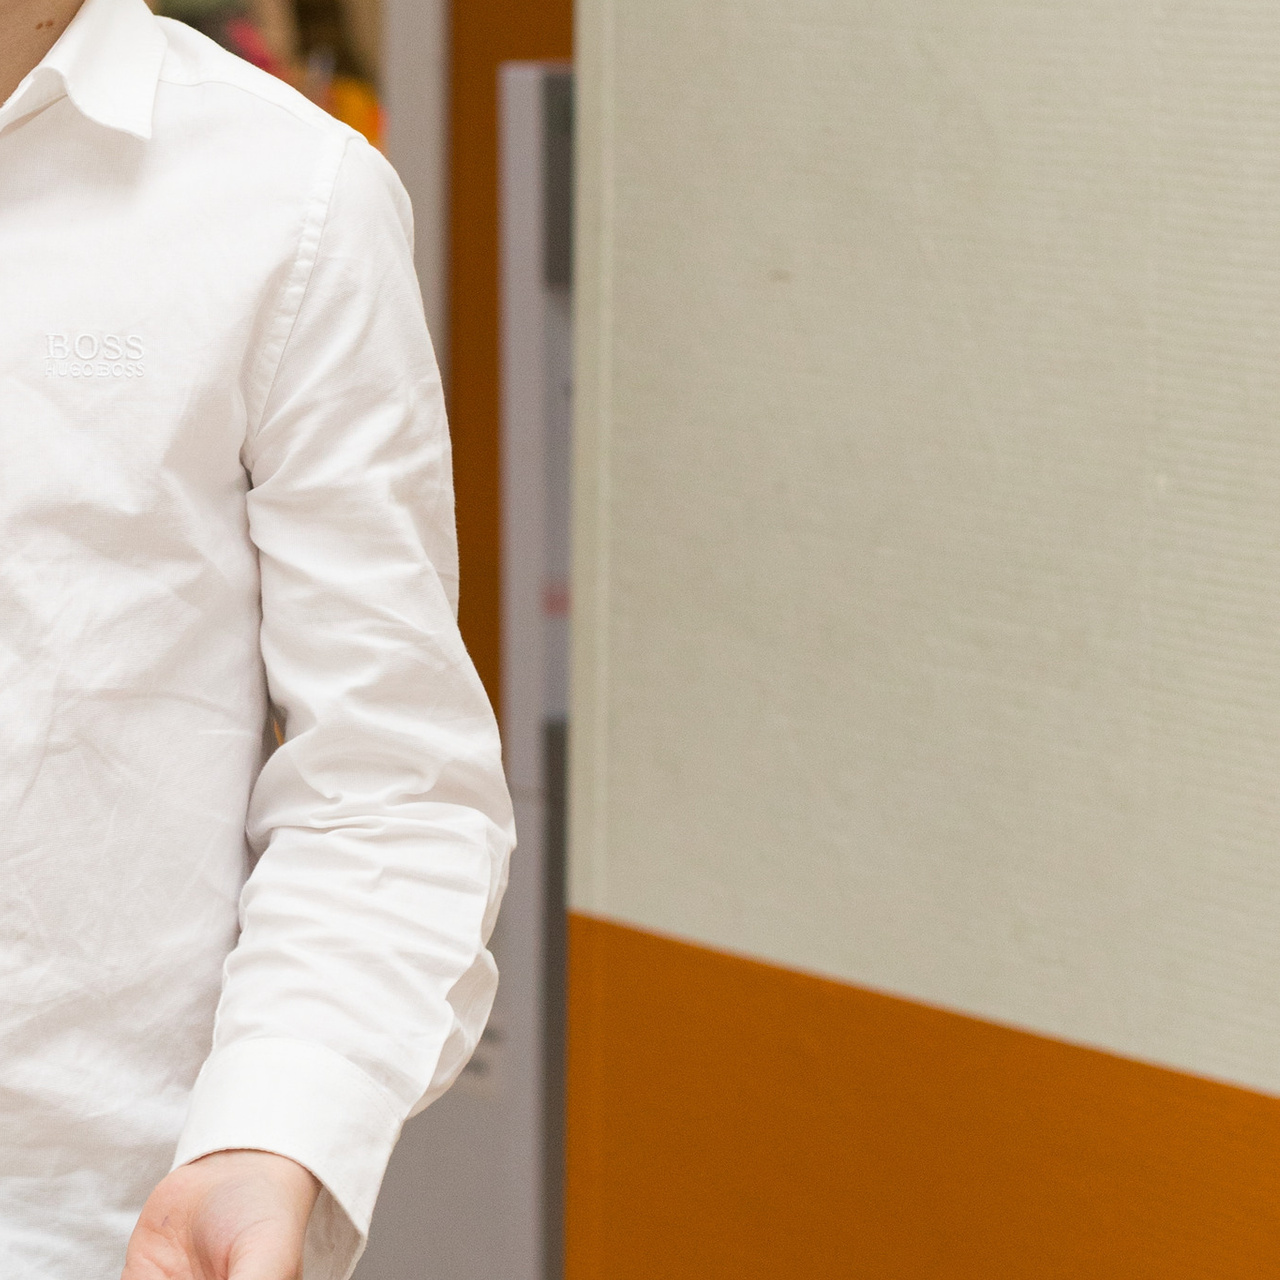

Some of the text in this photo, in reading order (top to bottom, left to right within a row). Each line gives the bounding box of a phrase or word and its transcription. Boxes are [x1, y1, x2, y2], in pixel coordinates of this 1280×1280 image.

[43, 333, 145, 361] BOSS
[44, 361, 145, 379] HUGO BOSS
